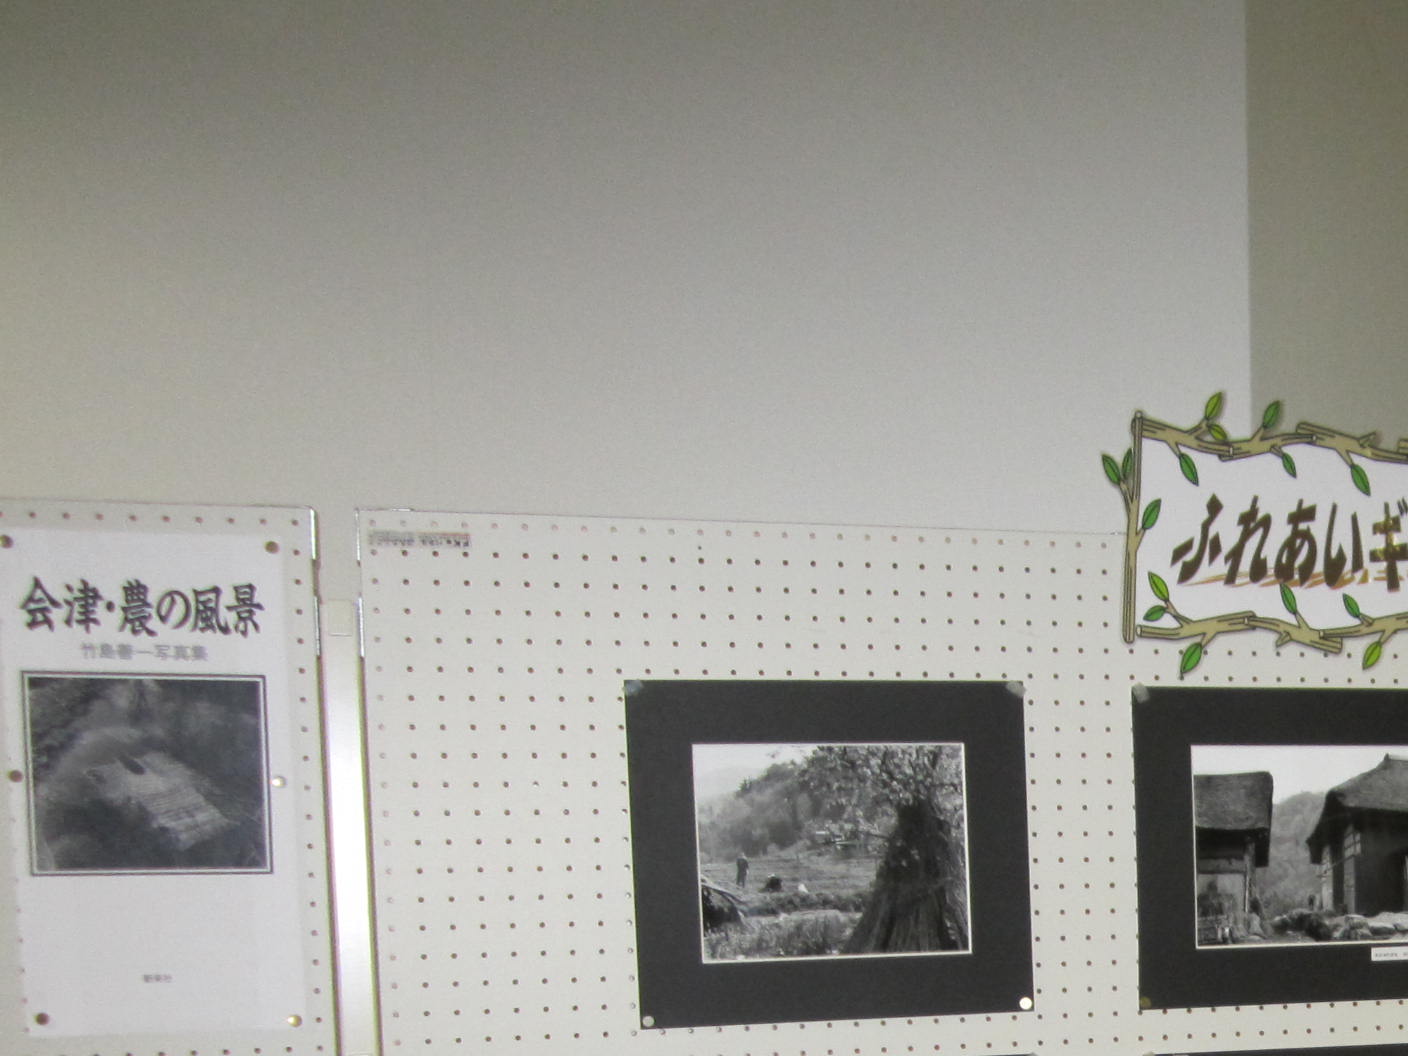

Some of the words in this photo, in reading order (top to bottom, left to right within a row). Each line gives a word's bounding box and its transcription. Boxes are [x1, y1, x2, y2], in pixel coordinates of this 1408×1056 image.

[20, 575, 265, 638] 会津・農の風景
